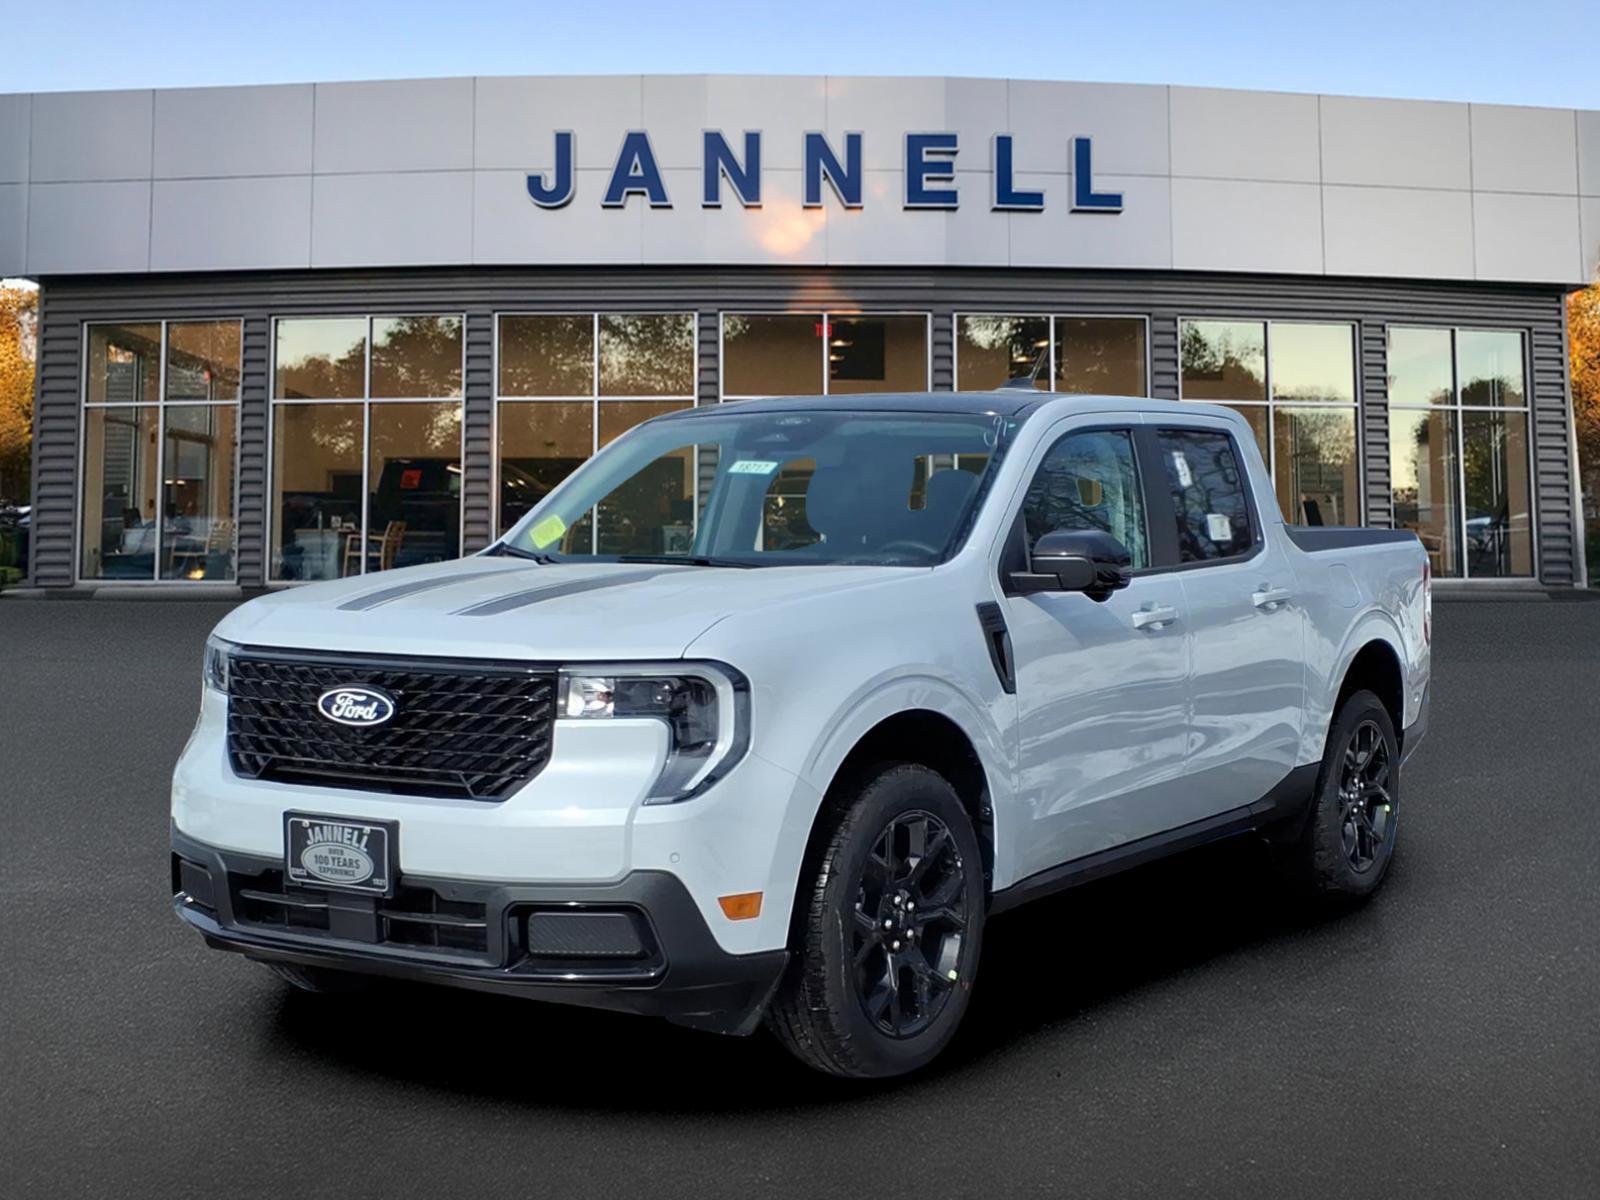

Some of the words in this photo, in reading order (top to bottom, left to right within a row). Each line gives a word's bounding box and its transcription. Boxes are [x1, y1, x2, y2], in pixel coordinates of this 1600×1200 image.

[525, 129, 1124, 213] JANNELL
[331, 692, 378, 720] Ford
[307, 825, 368, 852] JANNELL
[314, 855, 330, 865] 100
[331, 855, 361, 869] YEARS
[319, 867, 355, 877] EXPERIENCE
